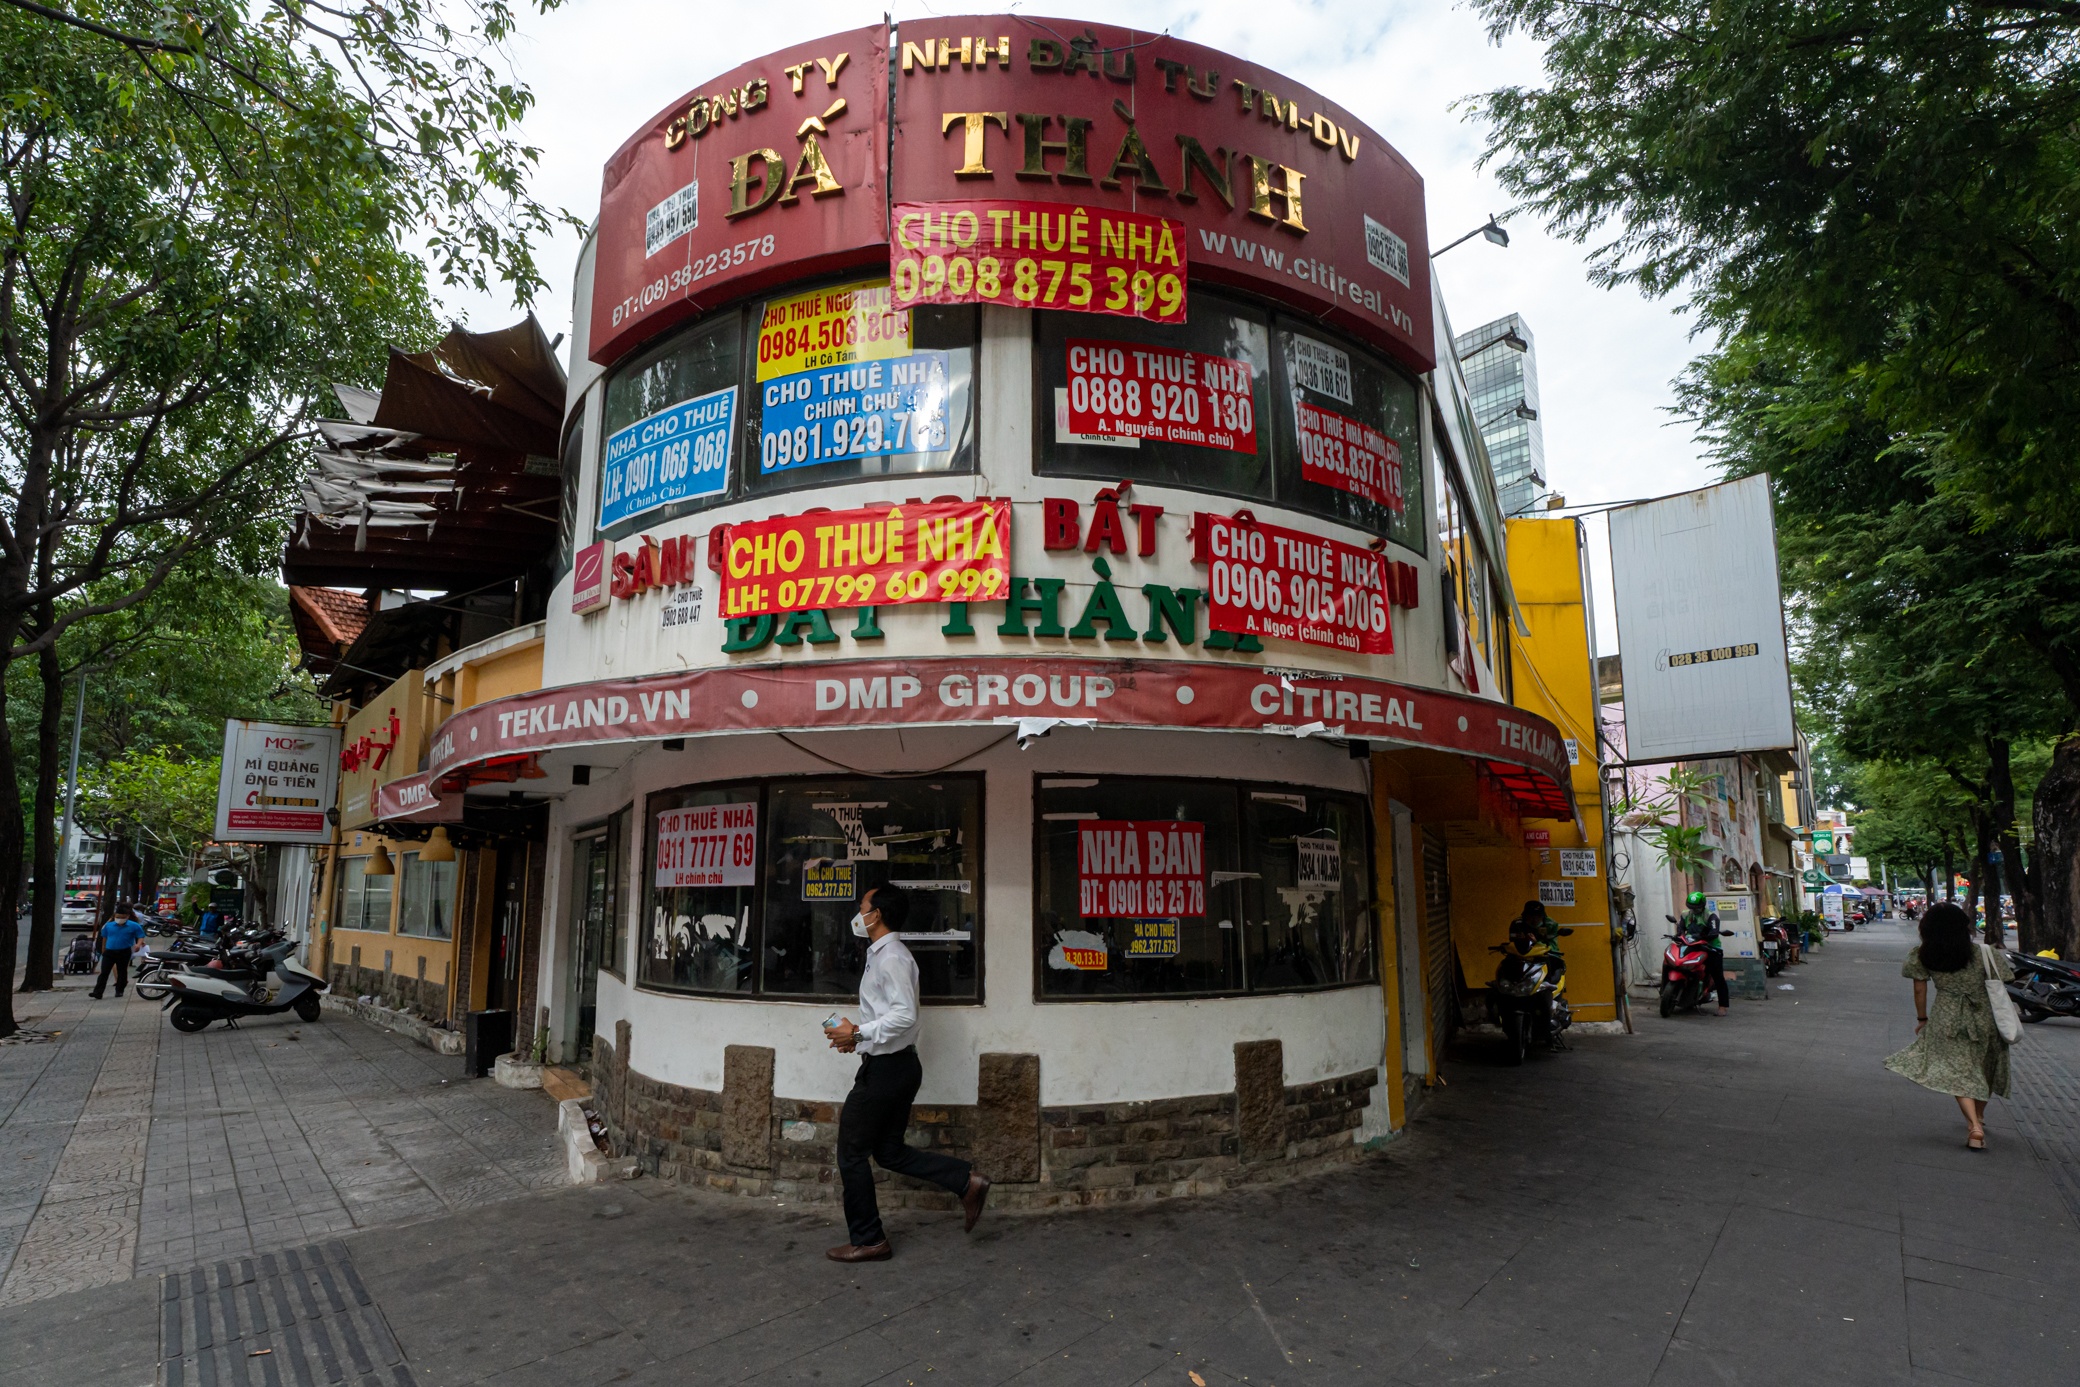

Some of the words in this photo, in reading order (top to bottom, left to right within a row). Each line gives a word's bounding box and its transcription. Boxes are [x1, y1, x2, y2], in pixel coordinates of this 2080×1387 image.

[665, 77, 769, 151] CÔNG
[784, 52, 850, 94] TY
[902, 36, 1009, 74] NHH
[1028, 28, 1136, 83] ĐẦU
[1154, 57, 1220, 100] TƯ
[1233, 78, 1361, 162] TM-DV
[724, 98, 848, 223] ĐẤ
[942, 98, 1310, 236] THÀNH
[682, 197, 697, 227] 550
[898, 209, 979, 250] CHO
[988, 207, 1089, 254] THUÊ
[1100, 218, 1180, 267] NHÀ
[1368, 233, 1385, 263] 0902
[612, 235, 776, 328] ĐT:(08)38223578
[896, 254, 1002, 303] 0908
[1012, 260, 1094, 305] 875
[1104, 267, 1183, 318] 399
[1200, 229, 1414, 336] www.citireal.vn
[762, 305, 787, 329] CHO
[790, 293, 821, 321] THUÊ
[805, 357, 817, 369] LH
[820, 354, 833, 364] Cô
[836, 349, 857, 362] Tám
[1070, 346, 1124, 376] CHO
[1133, 353, 1197, 385] THUÊ
[1204, 361, 1251, 396] NHÀ
[1297, 340, 1311, 357] CHO
[1312, 343, 1330, 365] THUÊ
[1335, 353, 1348, 371] BÁN
[765, 379, 811, 407] CHO
[819, 363, 882, 396] THUÊ
[892, 358, 945, 386] NHÀ
[1298, 359, 1318, 390] 0936
[1319, 367, 1334, 396] 168
[1335, 374, 1349, 400] 612
[804, 396, 856, 421] CHÍNH
[862, 387, 901, 411] CHỦ
[1071, 376, 1142, 417] 0888
[1151, 383, 1199, 424] 920
[1208, 389, 1252, 434] 130
[610, 428, 637, 461] NHÀ
[642, 416, 678, 444] CHO
[684, 395, 730, 428] THUÊ
[1098, 419, 1111, 431] A.
[1115, 420, 1163, 438] Nguyễn
[1167, 425, 1205, 443] (chính
[1208, 431, 1234, 450] chủ)
[1300, 407, 1320, 431] CHO
[1322, 413, 1344, 441] THUÊ
[1346, 422, 1363, 447] NHÀ
[1364, 428, 1386, 457] CHÍNH
[605, 465, 622, 507] LH:
[624, 450, 656, 498] 0901
[660, 439, 690, 484] 068
[693, 429, 727, 475] 968
[1301, 431, 1401, 498] 0933.837.119
[1350, 480, 1360, 492] Cô
[611, 534, 696, 600] SÀN
[1044, 479, 1164, 557] BẤT
[728, 529, 804, 579] CHO
[816, 508, 904, 568] THUÊ
[918, 502, 1003, 562] NHÀ
[1211, 524, 1266, 564] CHO
[1274, 541, 1333, 579] THUÊ
[1341, 552, 1383, 590] NHÀ
[678, 592, 688, 603] CHO
[727, 584, 769, 614] LH:
[778, 573, 876, 608] 07799
[885, 571, 928, 600] 60
[938, 568, 1003, 598] 999
[1212, 560, 1387, 633] 0906.905.006
[690, 605, 701, 622] 447
[1246, 615, 1259, 631] A.
[1263, 617, 1294, 639] Ngọc
[1299, 623, 1334, 644] (chính
[1337, 630, 1360, 652] chủ)
[1671, 652, 1692, 667] 028
[1694, 650, 1709, 663] 36
[1711, 647, 1733, 661] 000
[1735, 643, 1757, 658] 999
[498, 688, 691, 739] TEKLAND.VN
[815, 676, 921, 711] DMP
[938, 673, 1116, 707] GROUP
[1250, 684, 1423, 731] CITIREAL
[245, 772, 278, 786] ÔNG
[283, 774, 316, 788] TIẾN
[268, 759, 319, 774] QUẢNG
[399, 784, 427, 806] DMP
[839, 804, 862, 821] THUÊ
[660, 815, 680, 834] CHO
[684, 808, 718, 831] THUÊ
[723, 805, 755, 828] NHÀ
[1535, 832, 1548, 840] CAFE
[658, 837, 685, 870] 0911
[691, 835, 728, 868] 7777
[733, 833, 753, 867] 69
[1081, 822, 1141, 874] NHÀ
[1148, 823, 1201, 875] BÁN
[1300, 841, 1311, 849] CHO
[676, 873, 684, 885] LH
[685, 872, 706, 885] chính
[708, 870, 723, 884] chủ
[821, 868, 834, 881] CHO
[1563, 861, 1574, 871] 0931
[1575, 861, 1585, 871] 642
[1586, 861, 1595, 871] 166
[806, 883, 852, 897] 0962.377.673
[1081, 879, 1104, 915] ĐT:
[1108, 880, 1142, 914] 0901
[1147, 880, 1164, 914] 85
[1168, 880, 1185, 914] 25
[1188, 880, 1204, 914] 78
[1145, 923, 1157, 937] CHO
